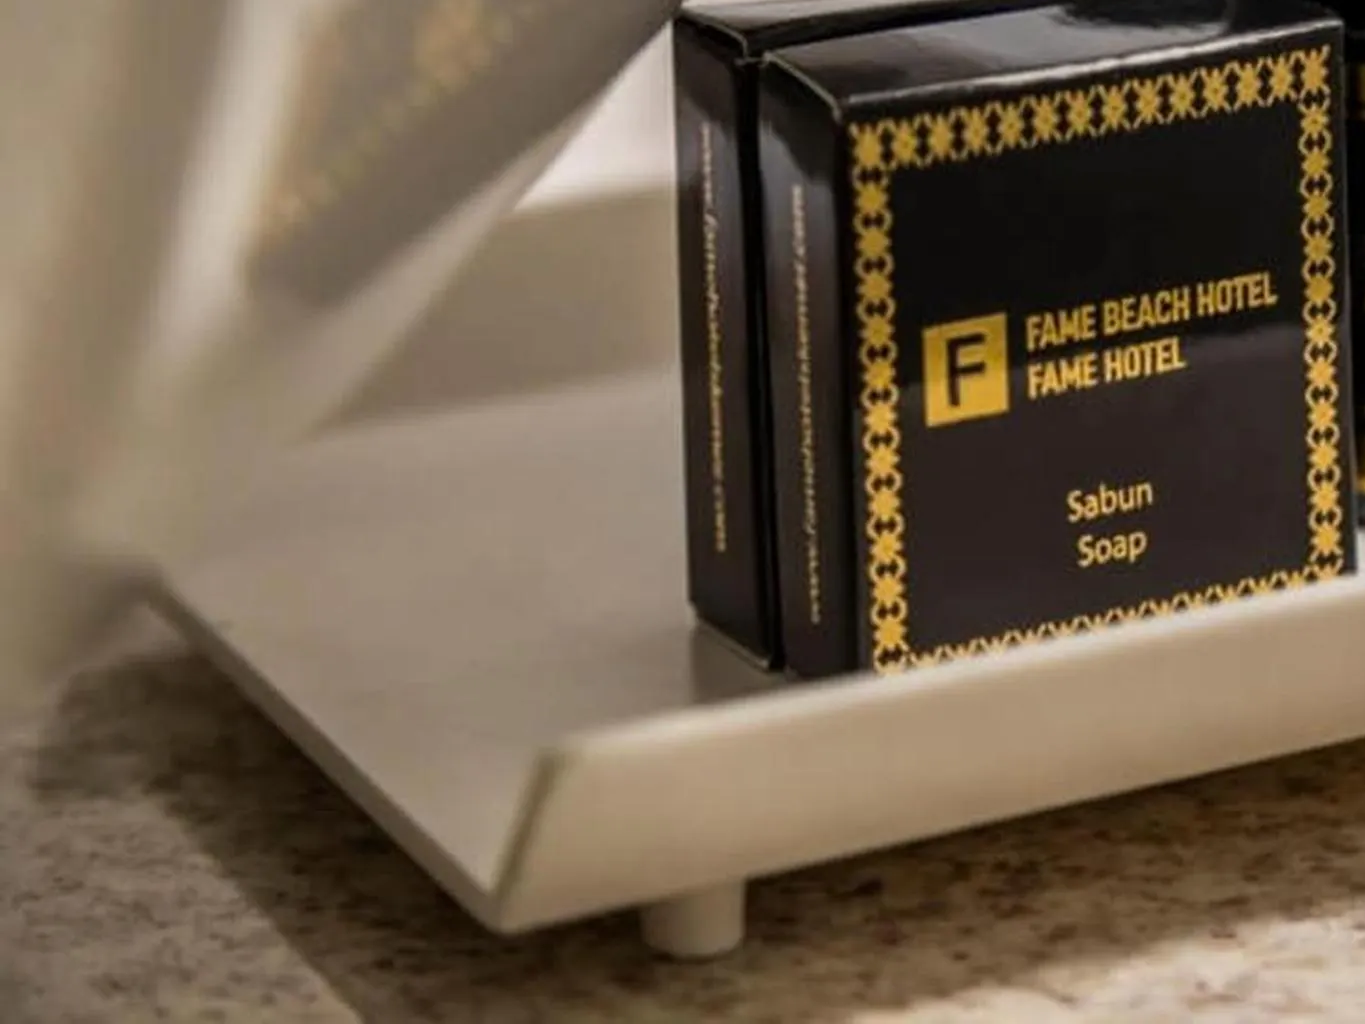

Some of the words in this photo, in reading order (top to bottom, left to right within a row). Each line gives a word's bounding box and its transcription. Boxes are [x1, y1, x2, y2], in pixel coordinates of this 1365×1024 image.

[1025, 304, 1097, 352] FAME
[1102, 284, 1190, 336] BEACH
[1196, 270, 1279, 317] HOTEL
[1026, 352, 1098, 401] FAME
[1103, 336, 1187, 385] HOTEL
[1065, 481, 1154, 523] Sabun
[1076, 530, 1148, 568] Soap
